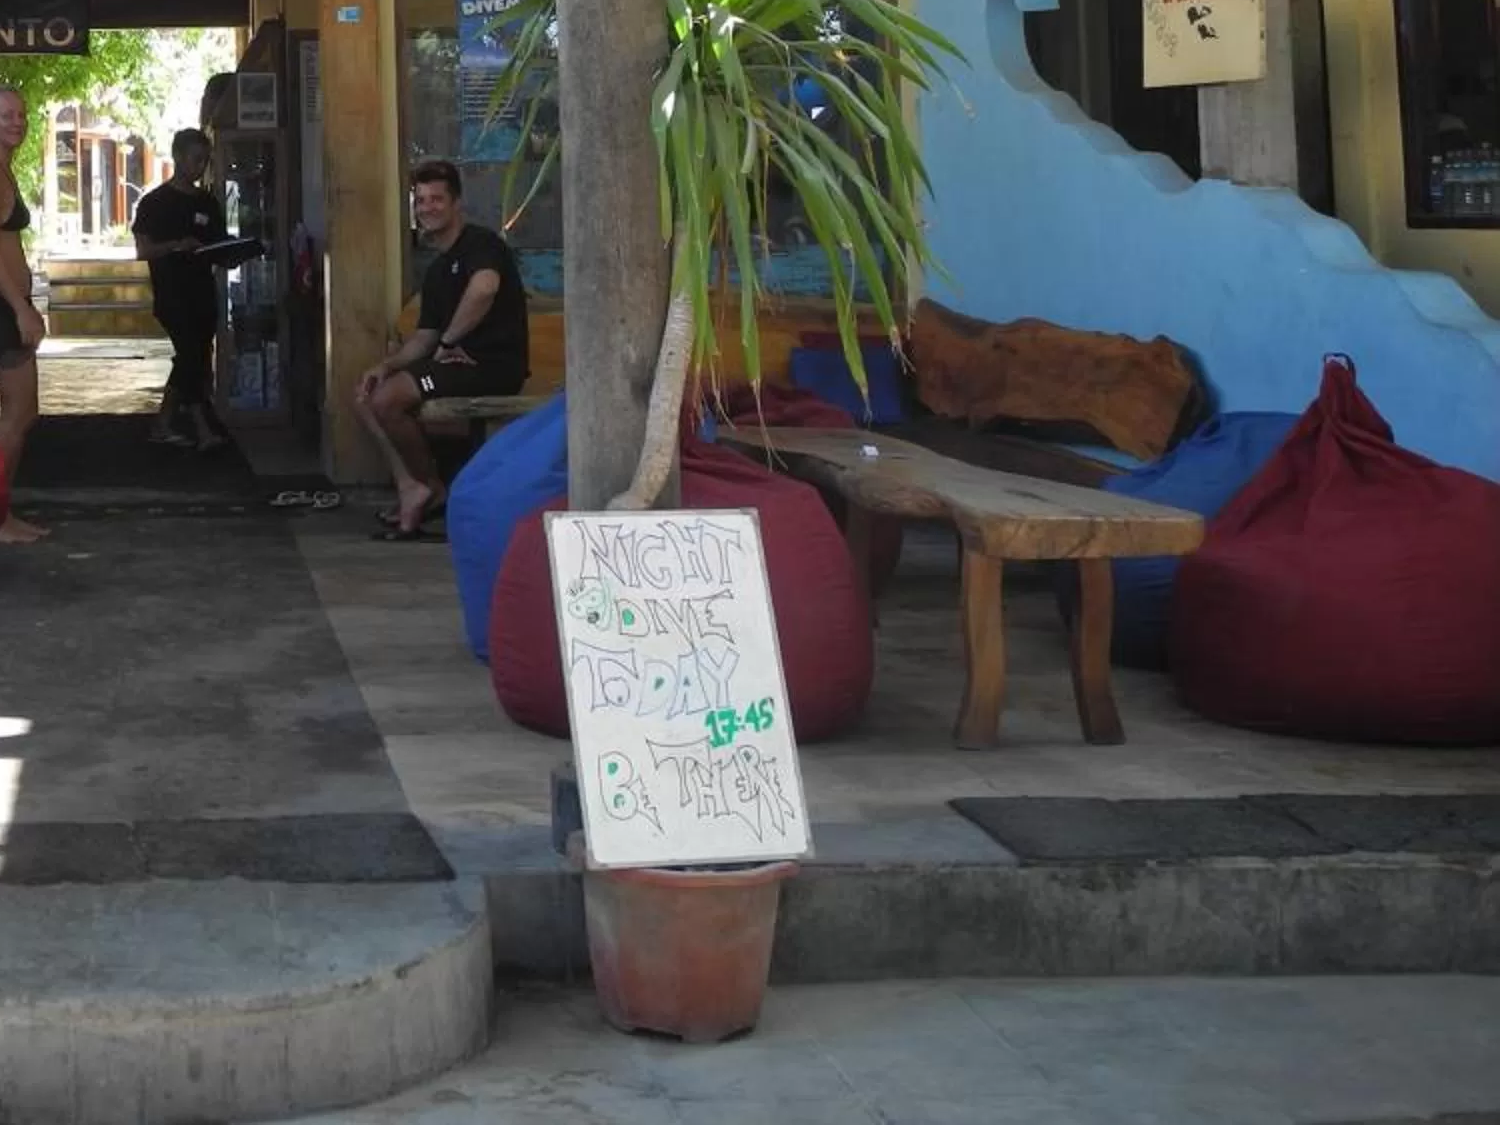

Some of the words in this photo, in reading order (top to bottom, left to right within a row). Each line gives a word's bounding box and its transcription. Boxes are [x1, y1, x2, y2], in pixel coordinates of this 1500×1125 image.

[572, 518, 742, 590] NIGHT
[614, 589, 736, 650] DIVE
[571, 638, 741, 720] TODAY
[705, 697, 775, 748] 17:45
[598, 751, 665, 835] BE
